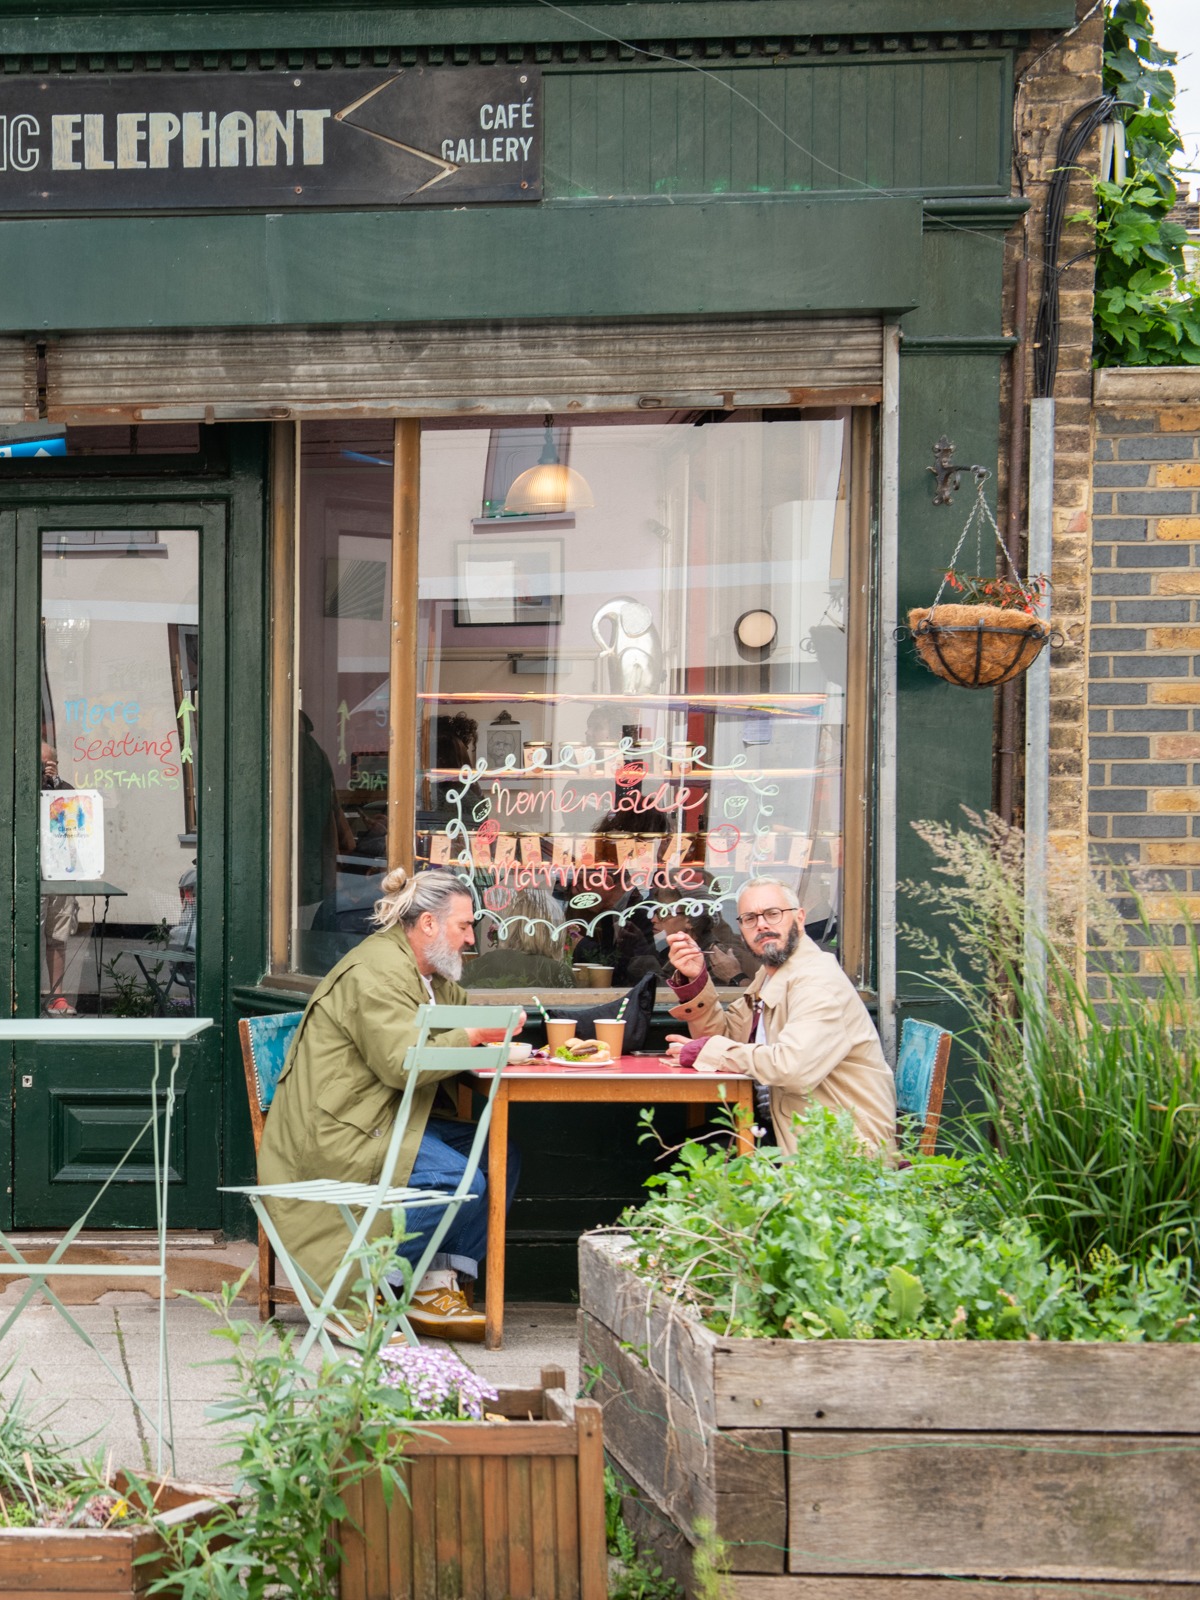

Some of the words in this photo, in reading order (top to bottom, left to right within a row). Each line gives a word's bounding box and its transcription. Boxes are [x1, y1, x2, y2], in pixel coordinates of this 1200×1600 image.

[479, 97, 535, 130] CAFÉ
[51, 108, 331, 171] ELEPHANT
[441, 136, 534, 164] GALLERY
[491, 778, 708, 816] homemade
[488, 857, 704, 892] marmalade
[432, 1294, 460, 1312] N
